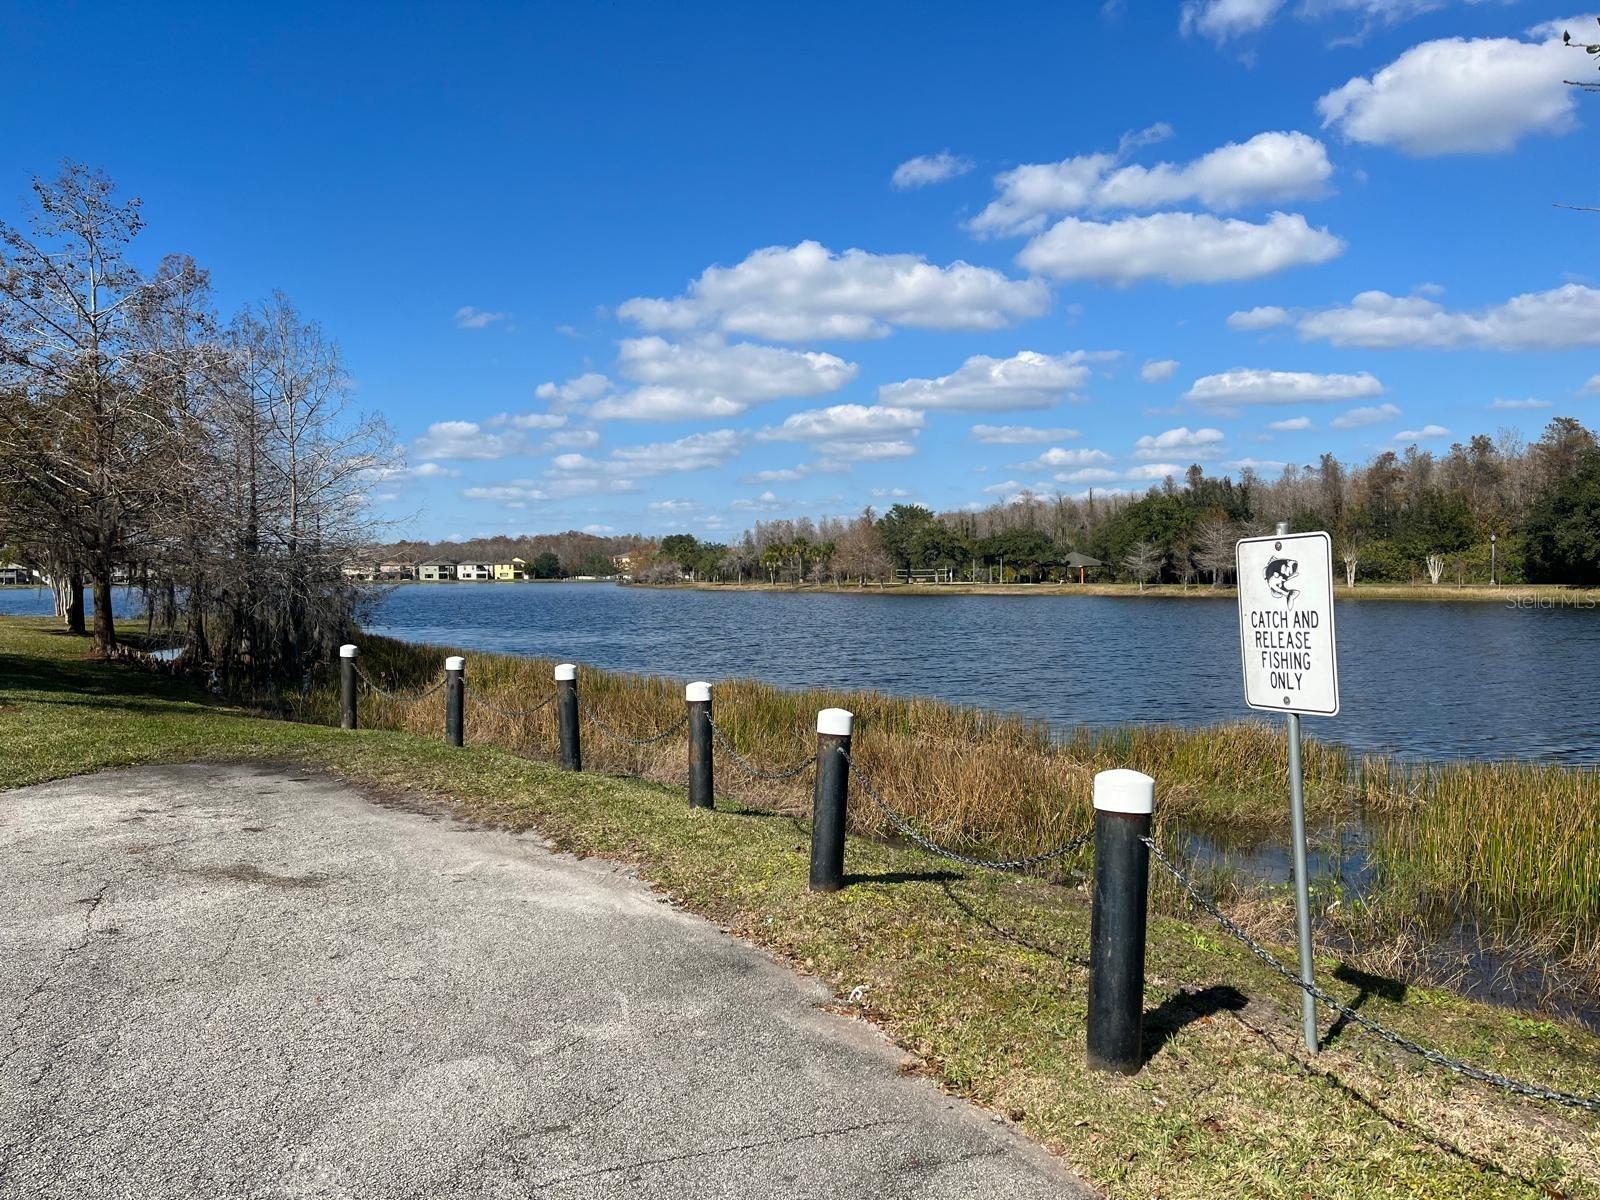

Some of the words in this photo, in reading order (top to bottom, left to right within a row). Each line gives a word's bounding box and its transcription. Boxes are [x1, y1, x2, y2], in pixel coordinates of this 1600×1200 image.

[1251, 610, 1288, 629] CATCH
[1293, 610, 1319, 629] AND
[1255, 631, 1311, 650] RELEASE
[1262, 651, 1311, 670] FISHING
[1270, 671, 1302, 690] ONLY
